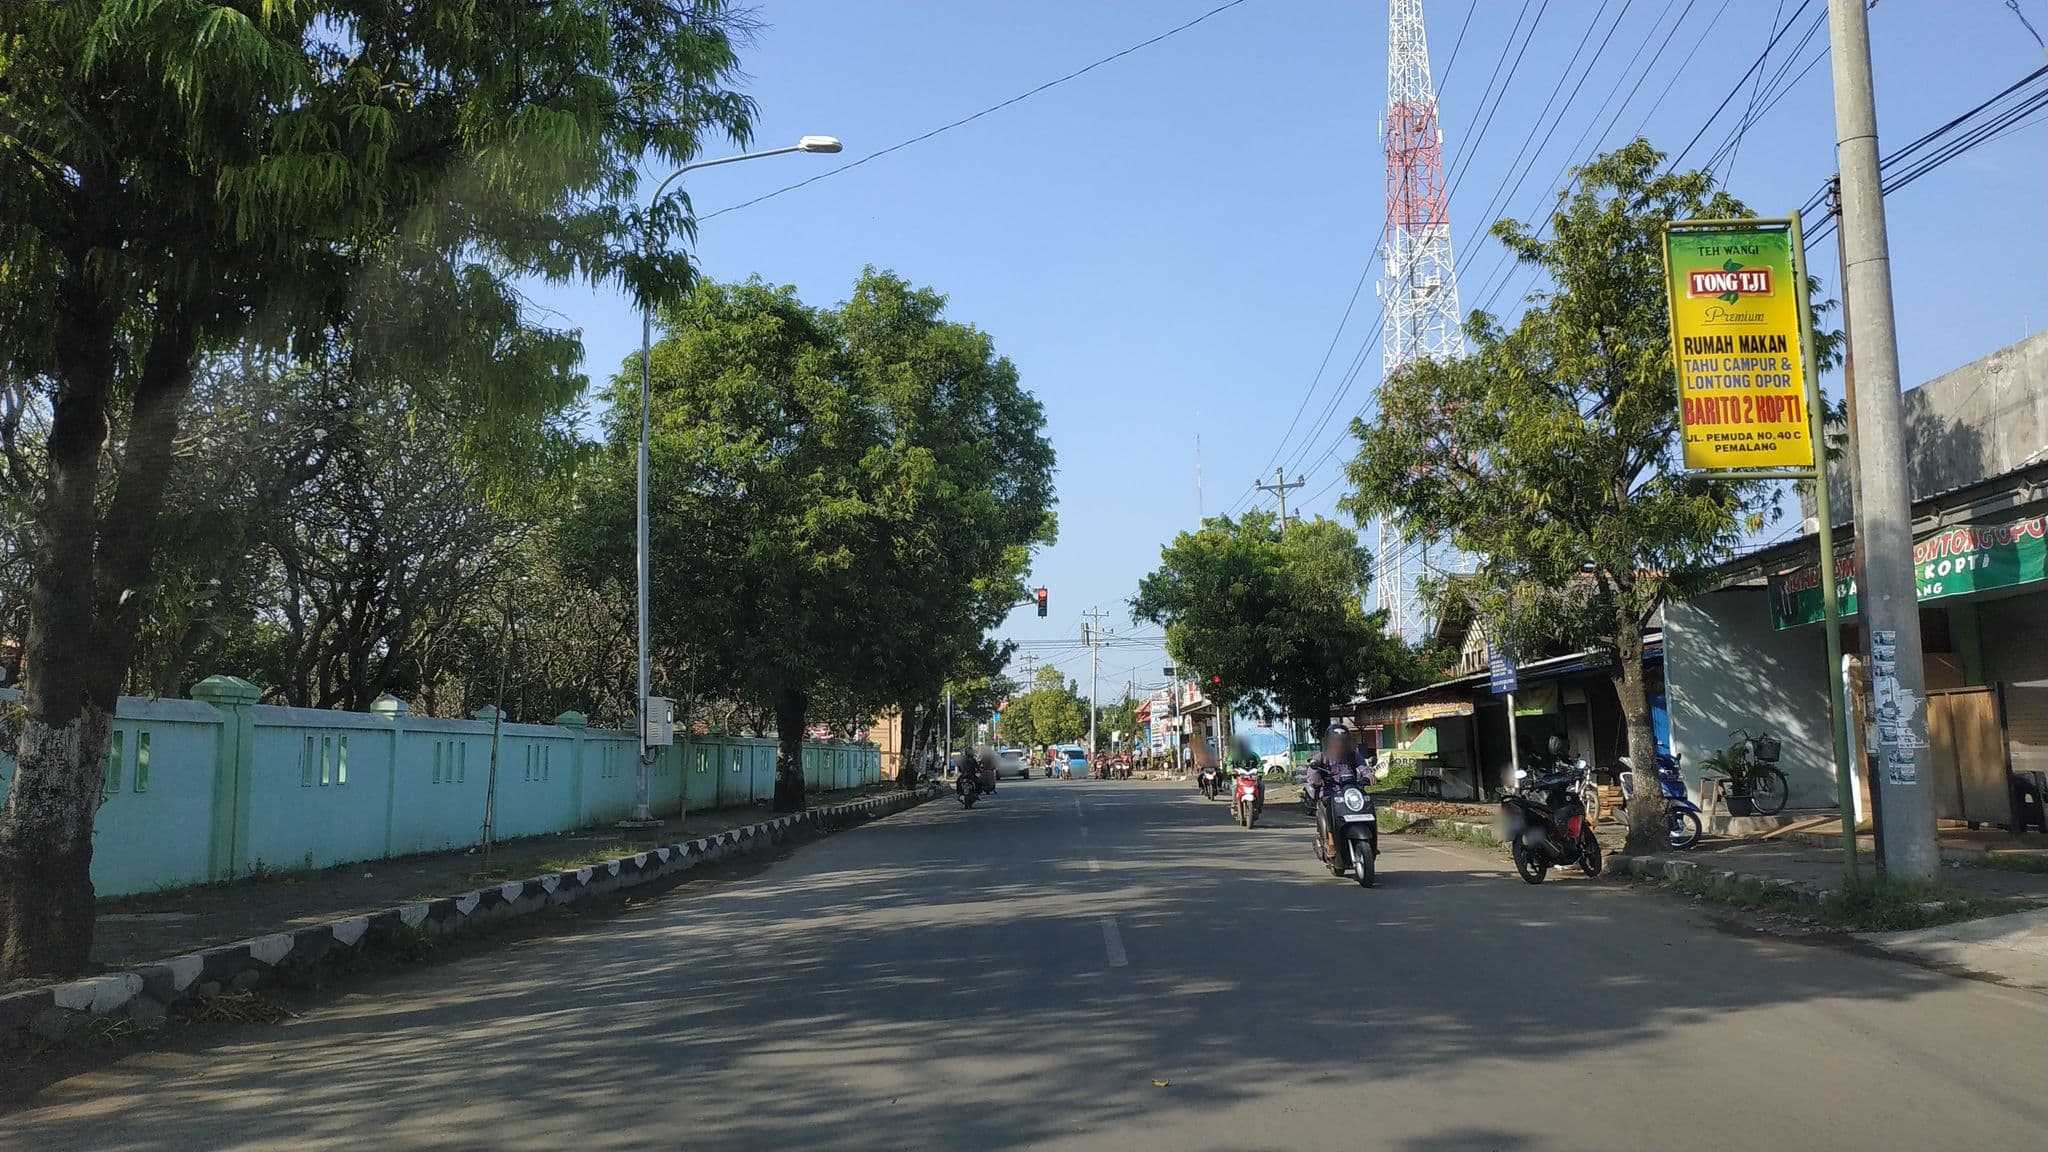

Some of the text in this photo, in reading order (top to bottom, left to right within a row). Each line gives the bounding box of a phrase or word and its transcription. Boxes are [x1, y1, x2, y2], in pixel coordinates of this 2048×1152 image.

[1698, 244, 1759, 256] TEH WANGI
[1693, 273, 1767, 292] TONG TJI
[1705, 306, 1765, 322] Premium
[1684, 334, 1787, 355] RUMAH MAKAN
[1684, 356, 1792, 373] TAHU CAMPUR &
[1687, 374, 1791, 390] LONTONG OPOR
[1684, 394, 1802, 425] BARITO 2 KOPTI
[1686, 434, 1704, 442] JL.
[1706, 432, 1754, 442] PEMUDA
[1715, 442, 1777, 452] PEMALANG
[1913, 527, 1994, 565] ONTONG
[2001, 516, 2048, 546] OPO
[1924, 553, 1990, 580] KOPTI
